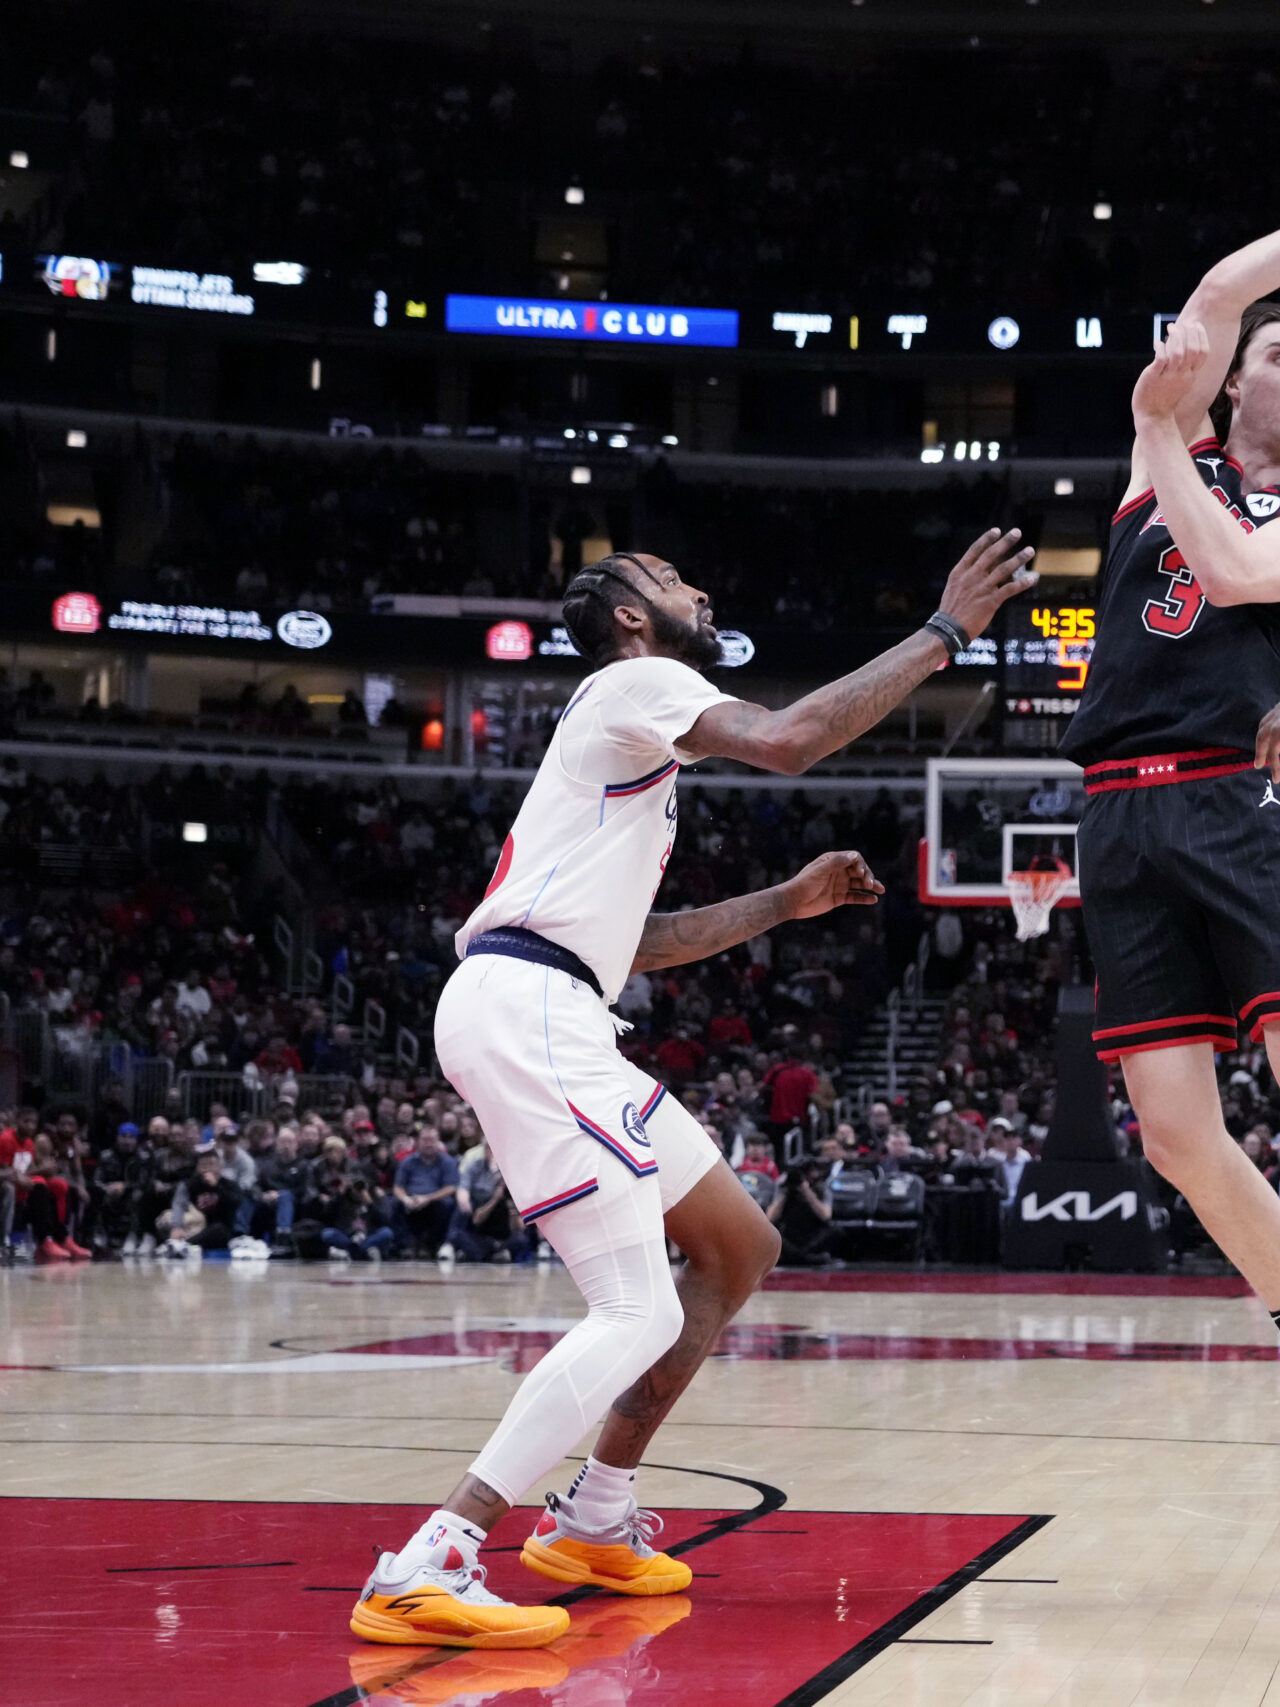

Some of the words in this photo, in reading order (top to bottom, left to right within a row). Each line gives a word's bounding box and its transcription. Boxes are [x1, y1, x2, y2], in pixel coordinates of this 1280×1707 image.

[496, 304, 578, 330] ULTRA
[602, 310, 689, 337] CLUB
[1076, 317, 1102, 347] LA
[1142, 544, 1206, 639] 3
[1031, 608, 1096, 638] 4:35
[1057, 638, 1089, 689] 5
[1022, 1190, 1137, 1221] KIA
